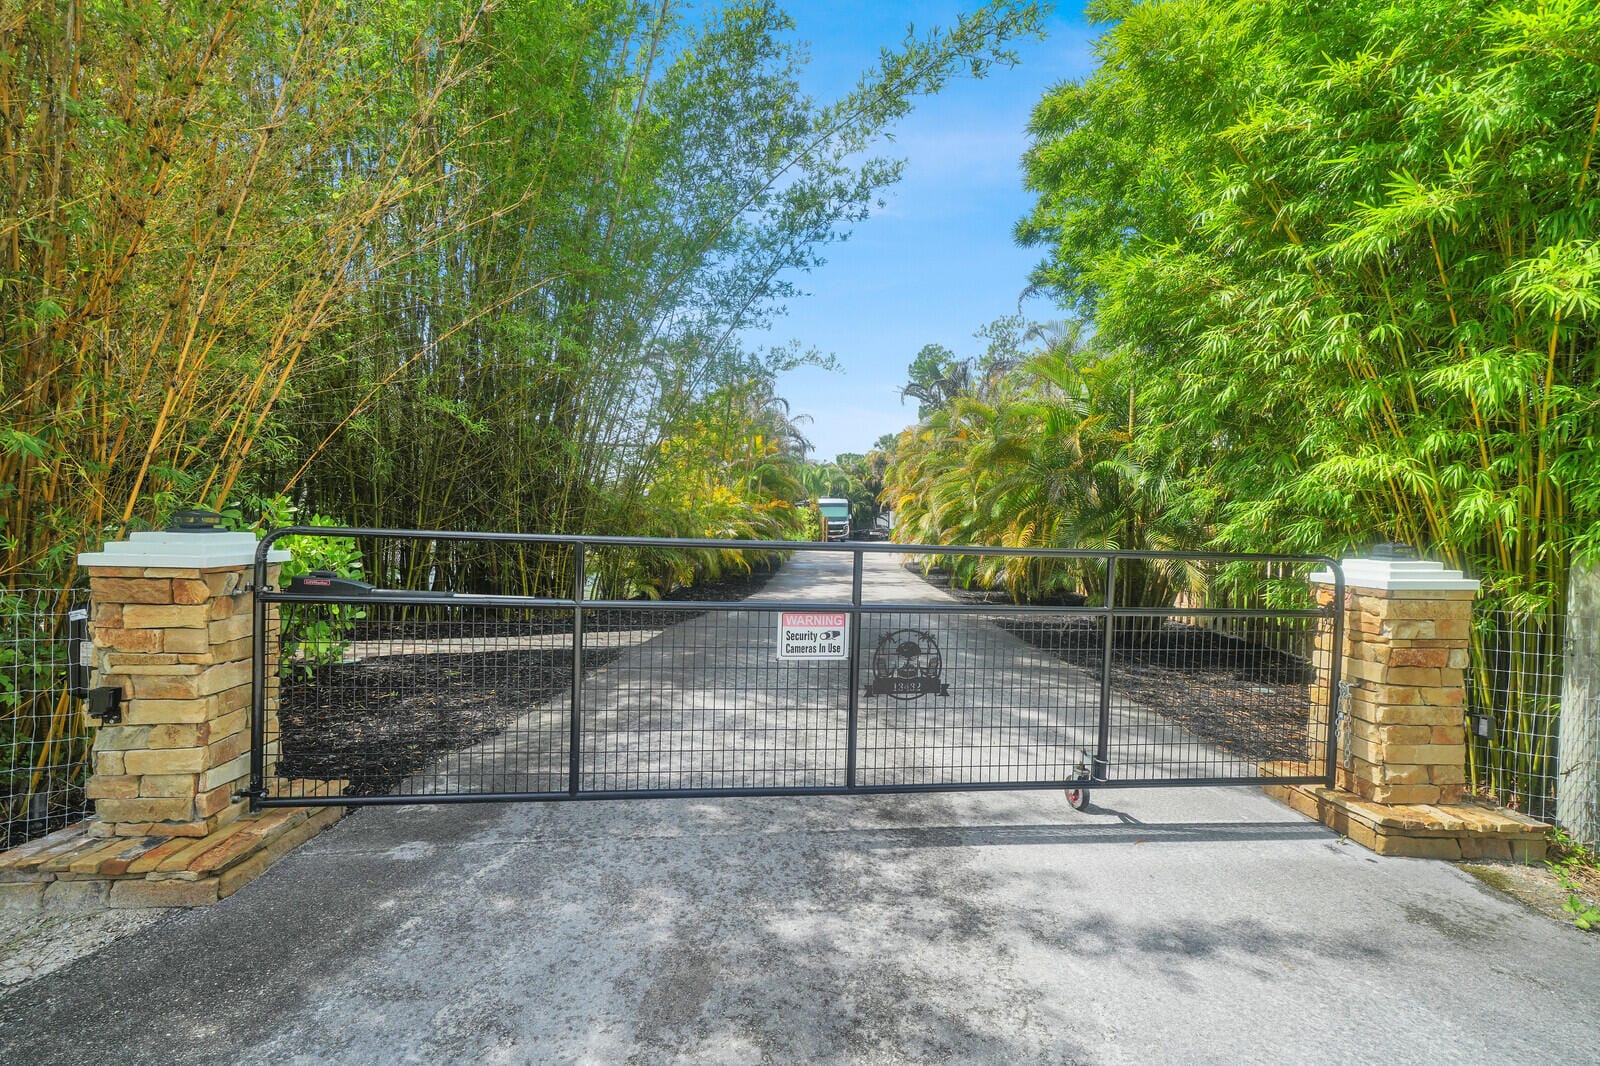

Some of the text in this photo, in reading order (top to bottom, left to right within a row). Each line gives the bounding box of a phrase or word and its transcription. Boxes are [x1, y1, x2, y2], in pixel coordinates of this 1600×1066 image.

[786, 615, 842, 625] WARNING
[786, 630, 817, 642] Security
[786, 643, 840, 653] Cameras In Use
